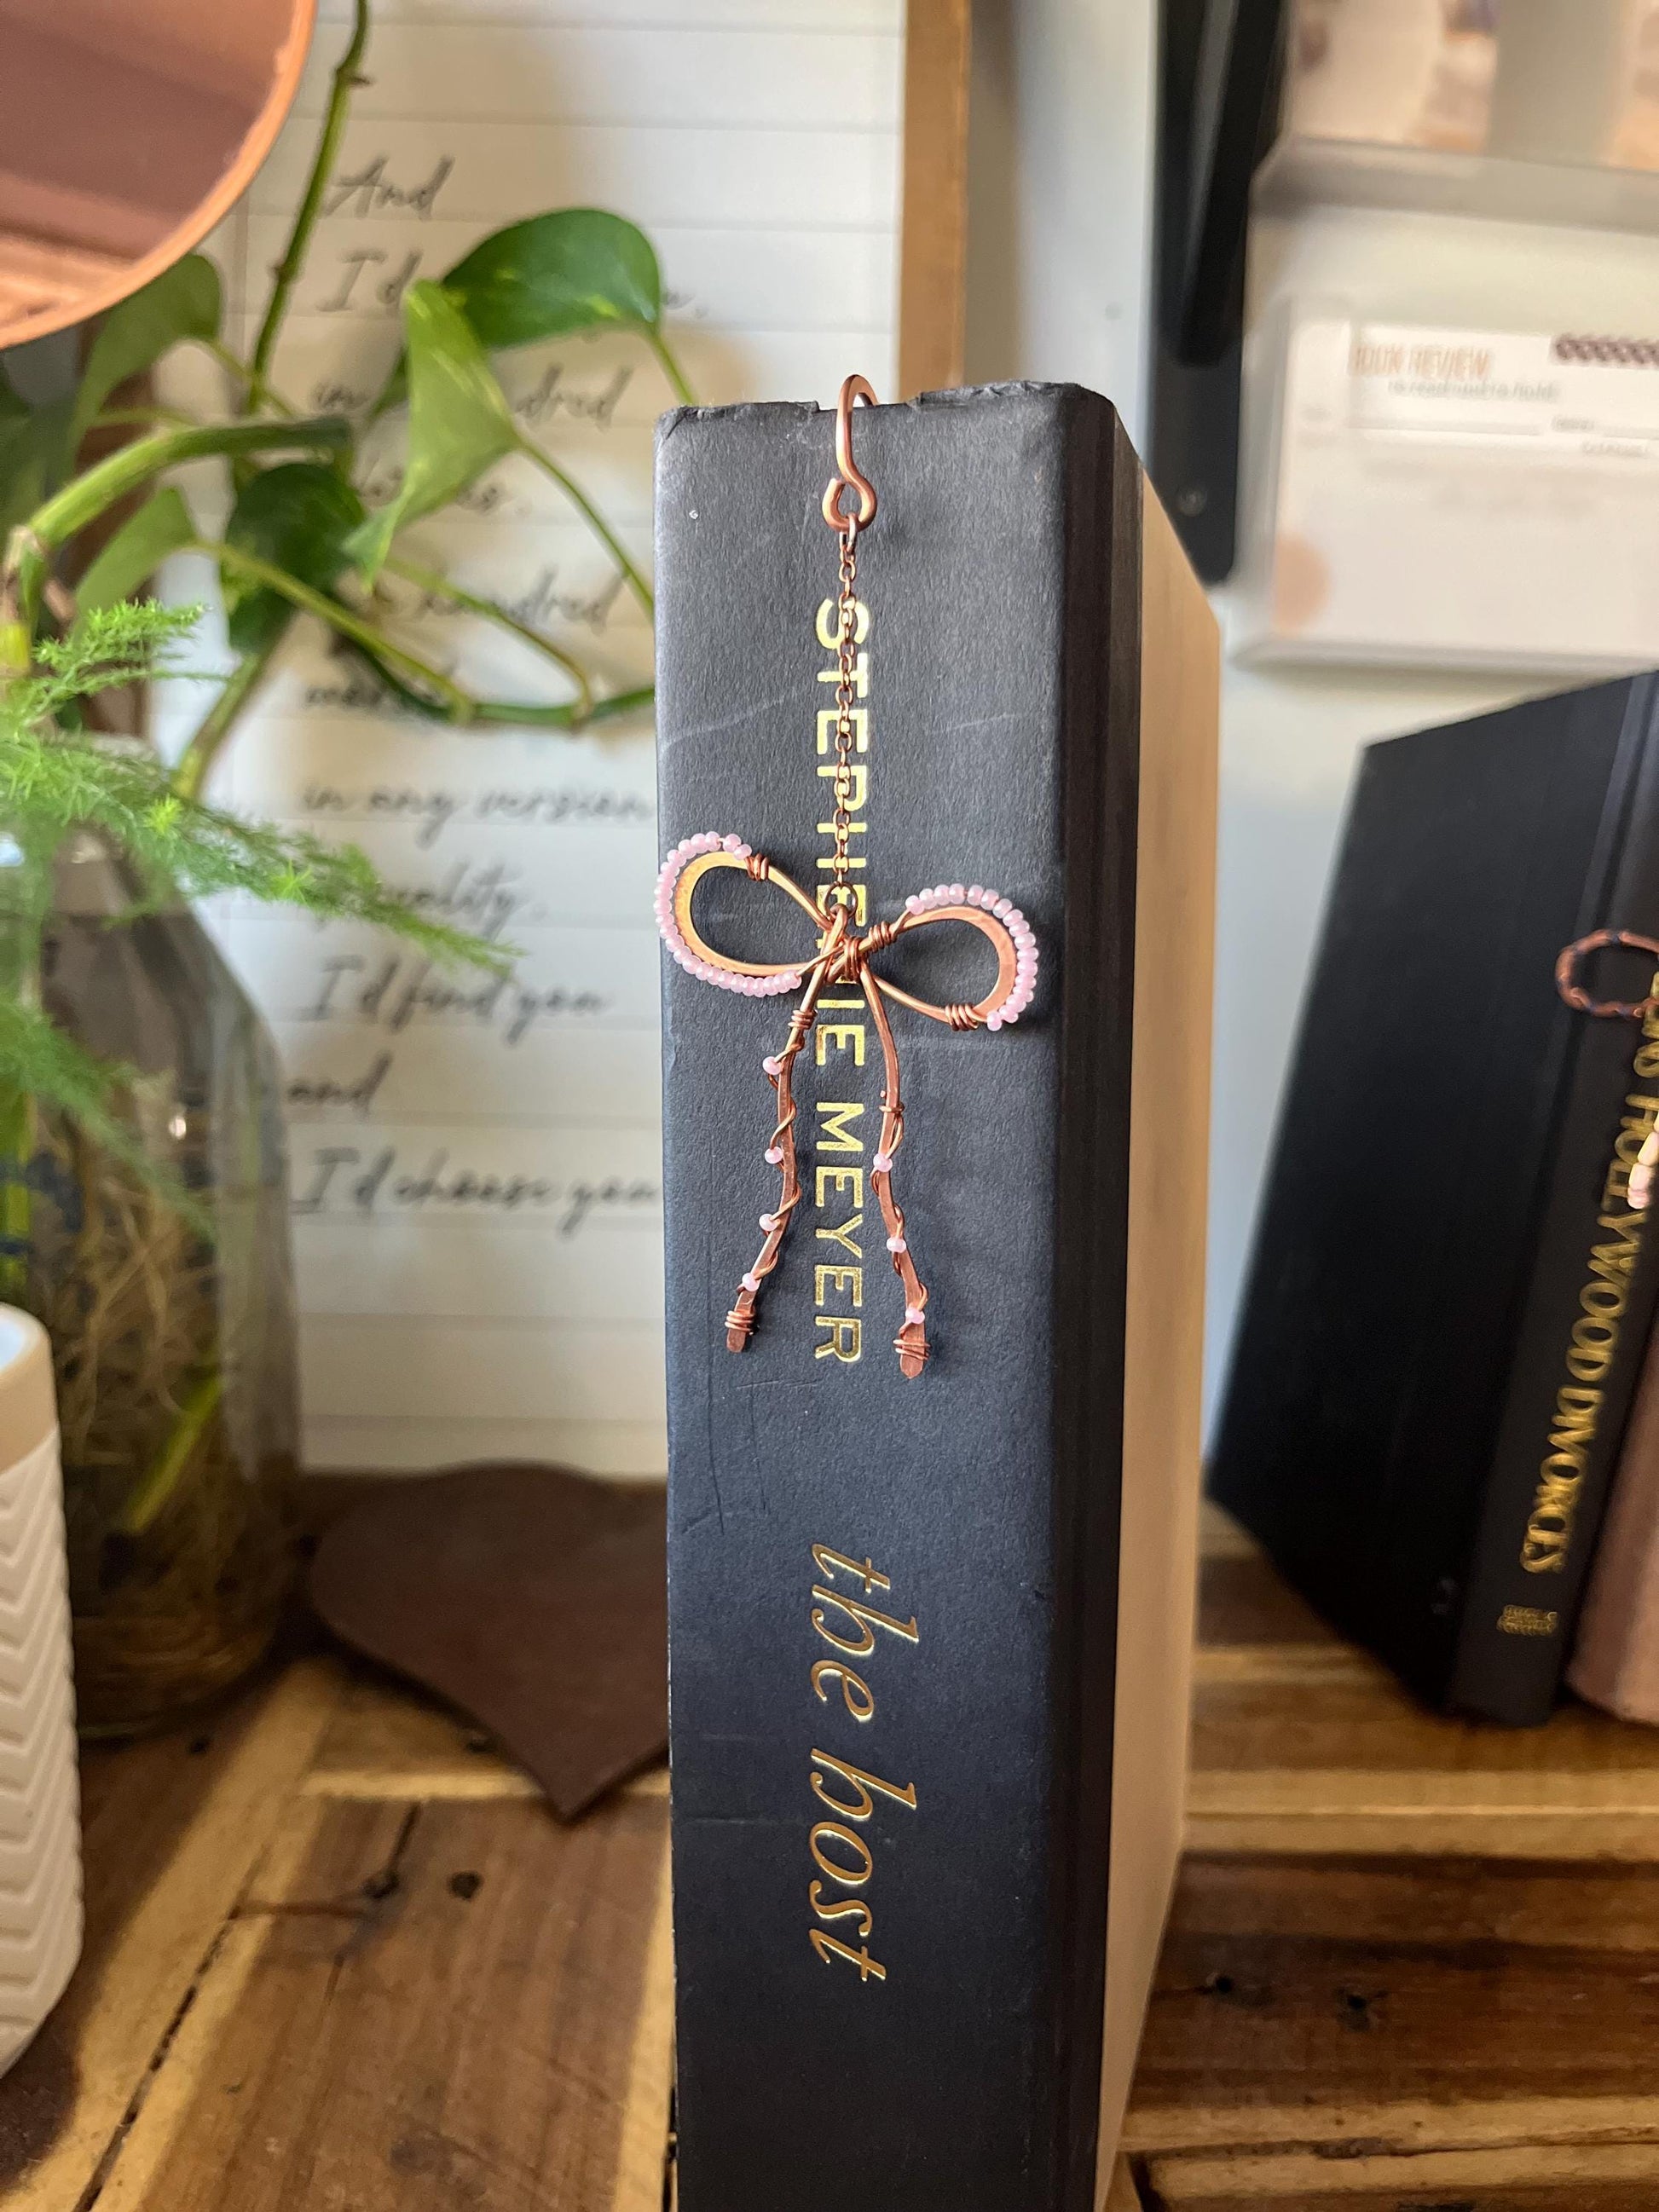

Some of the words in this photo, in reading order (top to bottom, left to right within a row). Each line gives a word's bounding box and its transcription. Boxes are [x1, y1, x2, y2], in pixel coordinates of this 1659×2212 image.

[319, 152, 457, 222] And
[367, 781, 459, 851] any
[476, 783, 655, 823] version
[816, 597, 871, 1067] STEPHEIE
[503, 980, 610, 1048] you
[286, 1048, 394, 1118] and
[394, 1146, 556, 1212] choose
[556, 1176, 658, 1241] you
[814, 1100, 866, 1364] MEYER
[1519, 1385, 1604, 1574] DIVORCES
[811, 1542, 920, 1721] the
[809, 1747, 918, 1983] host
